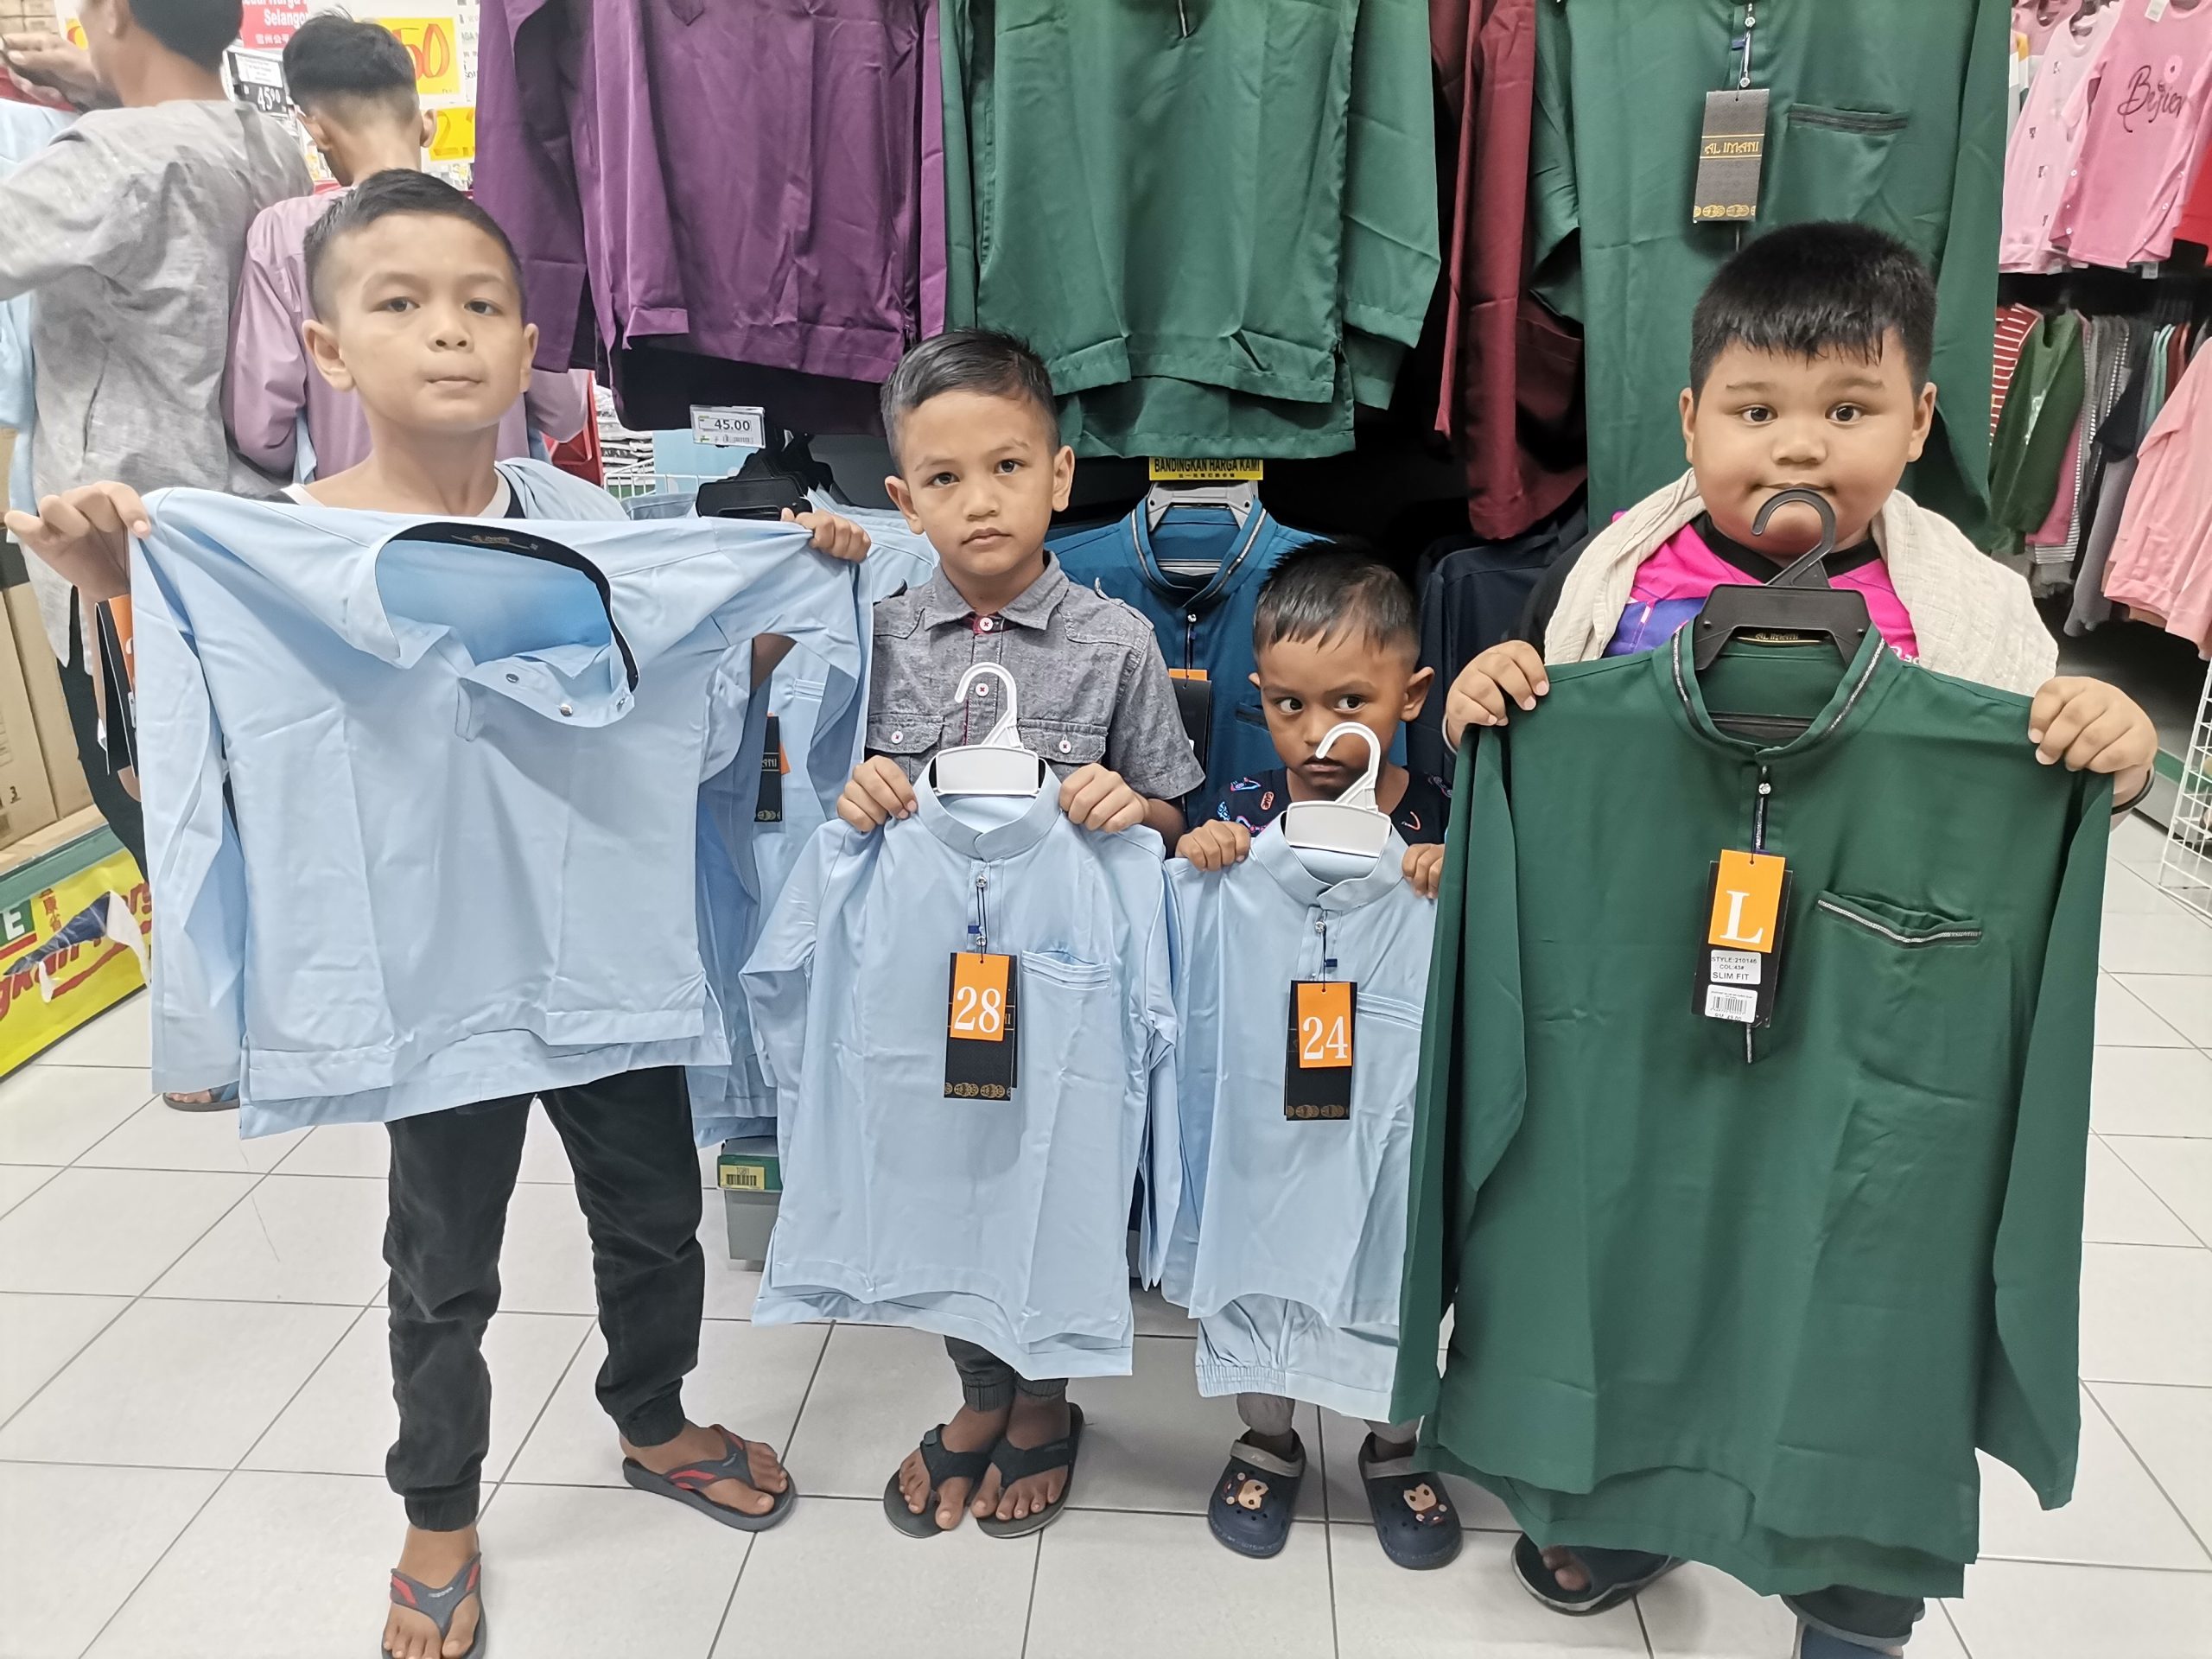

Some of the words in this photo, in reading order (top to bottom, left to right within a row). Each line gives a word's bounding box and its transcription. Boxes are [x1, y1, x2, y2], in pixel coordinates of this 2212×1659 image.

[1704, 143, 1720, 154] AL
[1723, 141, 1759, 153] IMANI
[714, 419, 750, 431] 45.00
[1154, 458, 1207, 472] BANDINGKAN
[1209, 458, 1237, 472] HARGA
[1239, 459, 1260, 472] KAMI
[1719, 890, 1764, 944] L
[1713, 971, 1734, 980] SLIM
[954, 986, 1001, 1033] 28
[1302, 1016, 1349, 1060] 24
